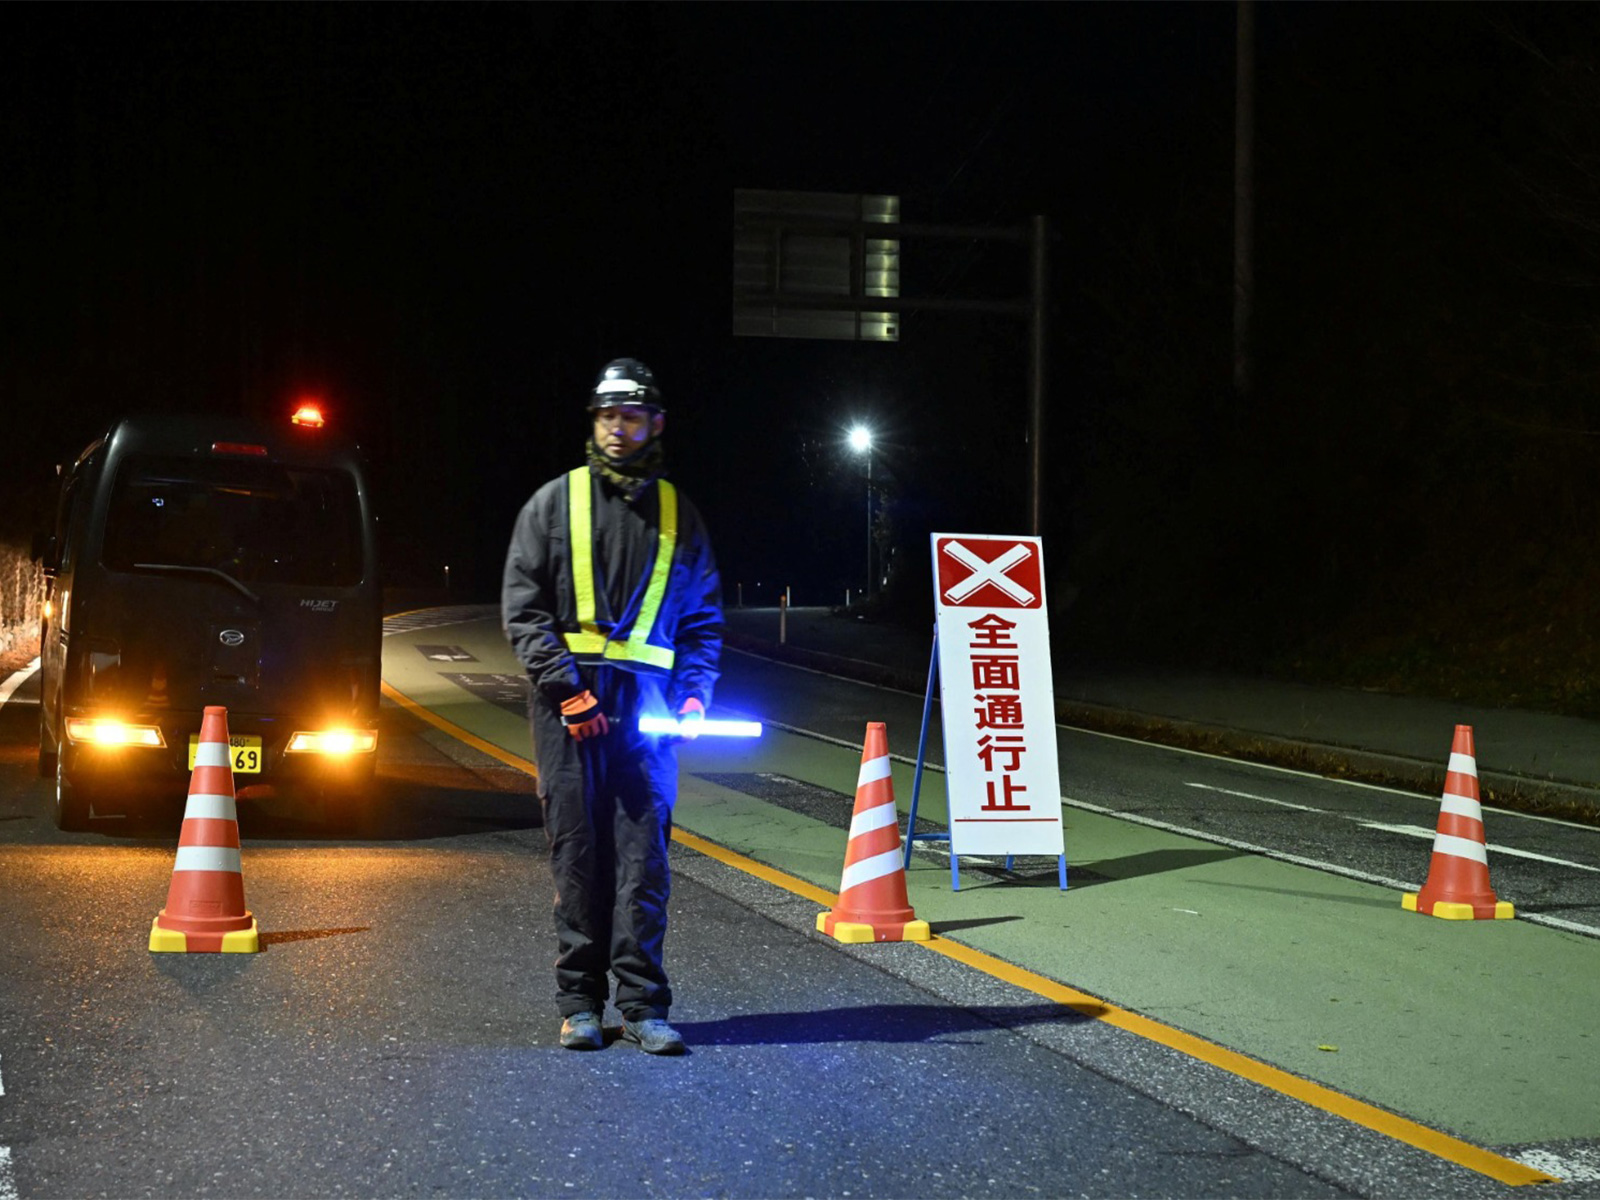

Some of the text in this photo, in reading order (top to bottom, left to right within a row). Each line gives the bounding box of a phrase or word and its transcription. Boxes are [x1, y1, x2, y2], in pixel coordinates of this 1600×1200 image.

[300, 599, 339, 607] HIJET
[967, 613, 1031, 811] 全面通行止
